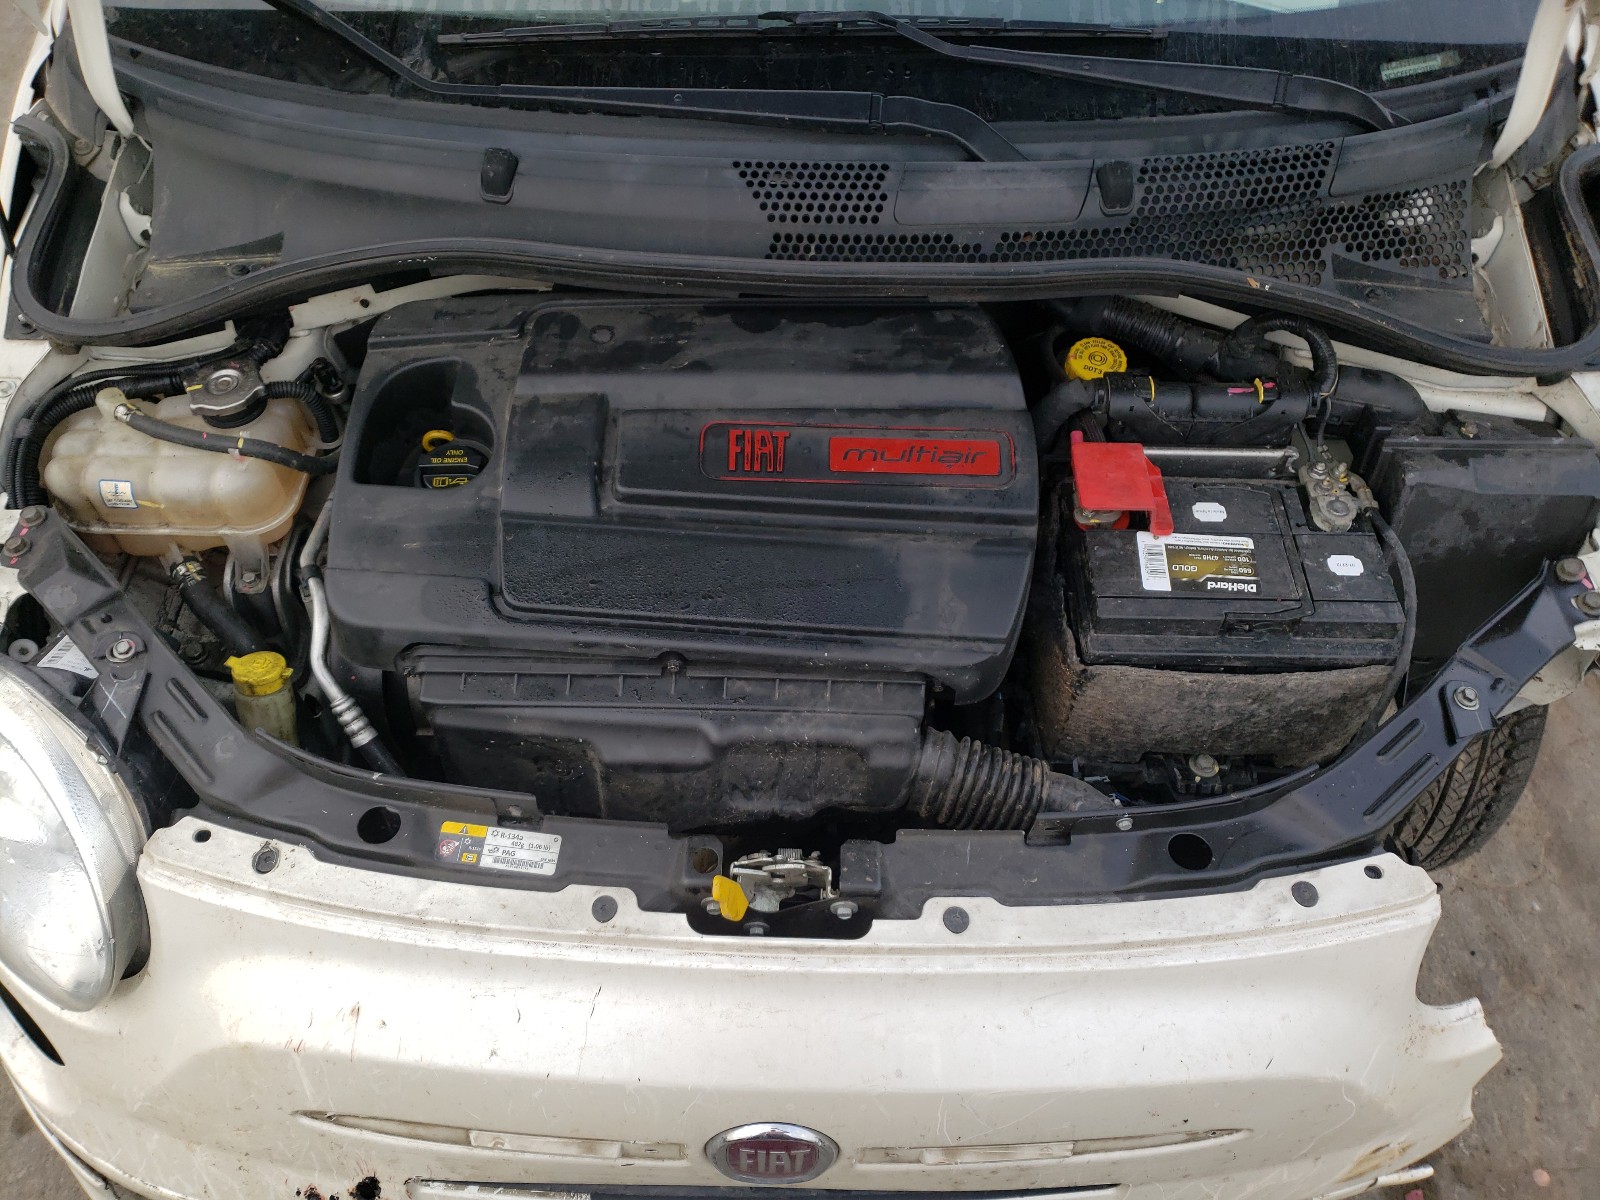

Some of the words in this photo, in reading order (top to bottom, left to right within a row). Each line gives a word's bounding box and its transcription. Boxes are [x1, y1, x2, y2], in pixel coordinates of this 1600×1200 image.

[728, 430, 791, 472] FIAT
[842, 447, 990, 468] multiair
[1172, 564, 1198, 572] GOLD
[1207, 581, 1257, 593] DieHard
[500, 831, 524, 841] R-134a
[501, 849, 516, 857] PAG
[740, 1148, 811, 1173] FIAT
